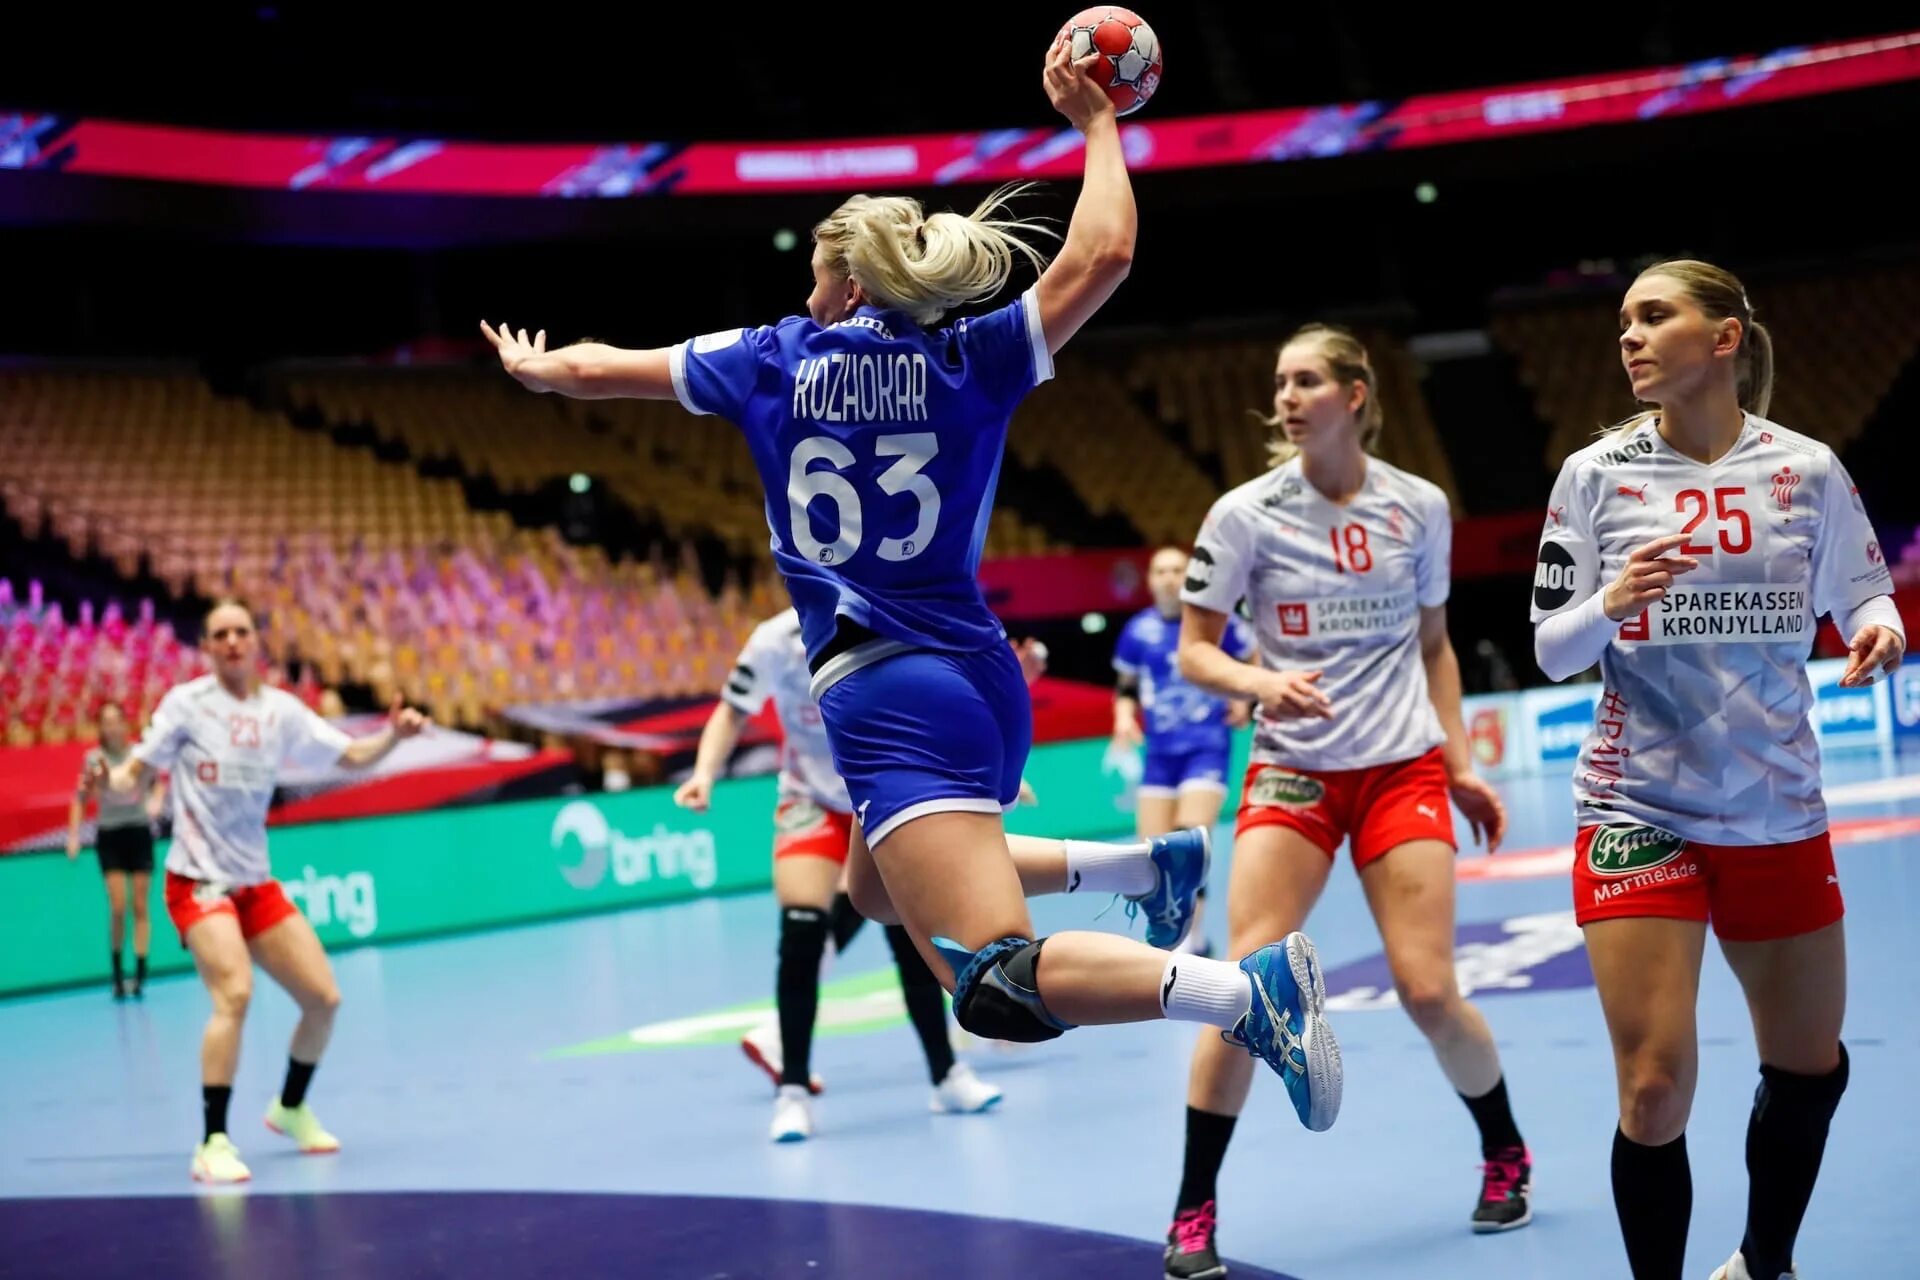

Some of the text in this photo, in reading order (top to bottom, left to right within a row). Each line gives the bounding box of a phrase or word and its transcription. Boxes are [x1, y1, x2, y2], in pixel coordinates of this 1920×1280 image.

[793, 353, 928, 421] KOZHOKAR
[787, 431, 941, 567] 63
[1675, 487, 1752, 555] 25
[1330, 521, 1373, 574] 18
[1317, 594, 1408, 617] SPAREKAS
[1318, 612, 1407, 635] KRONJYLL
[1661, 591, 1804, 613] SPAREKASSEN
[1662, 615, 1803, 637] KRONJYLLAND
[284, 864, 379, 937] ring
[1593, 862, 1697, 907] Marmelade
